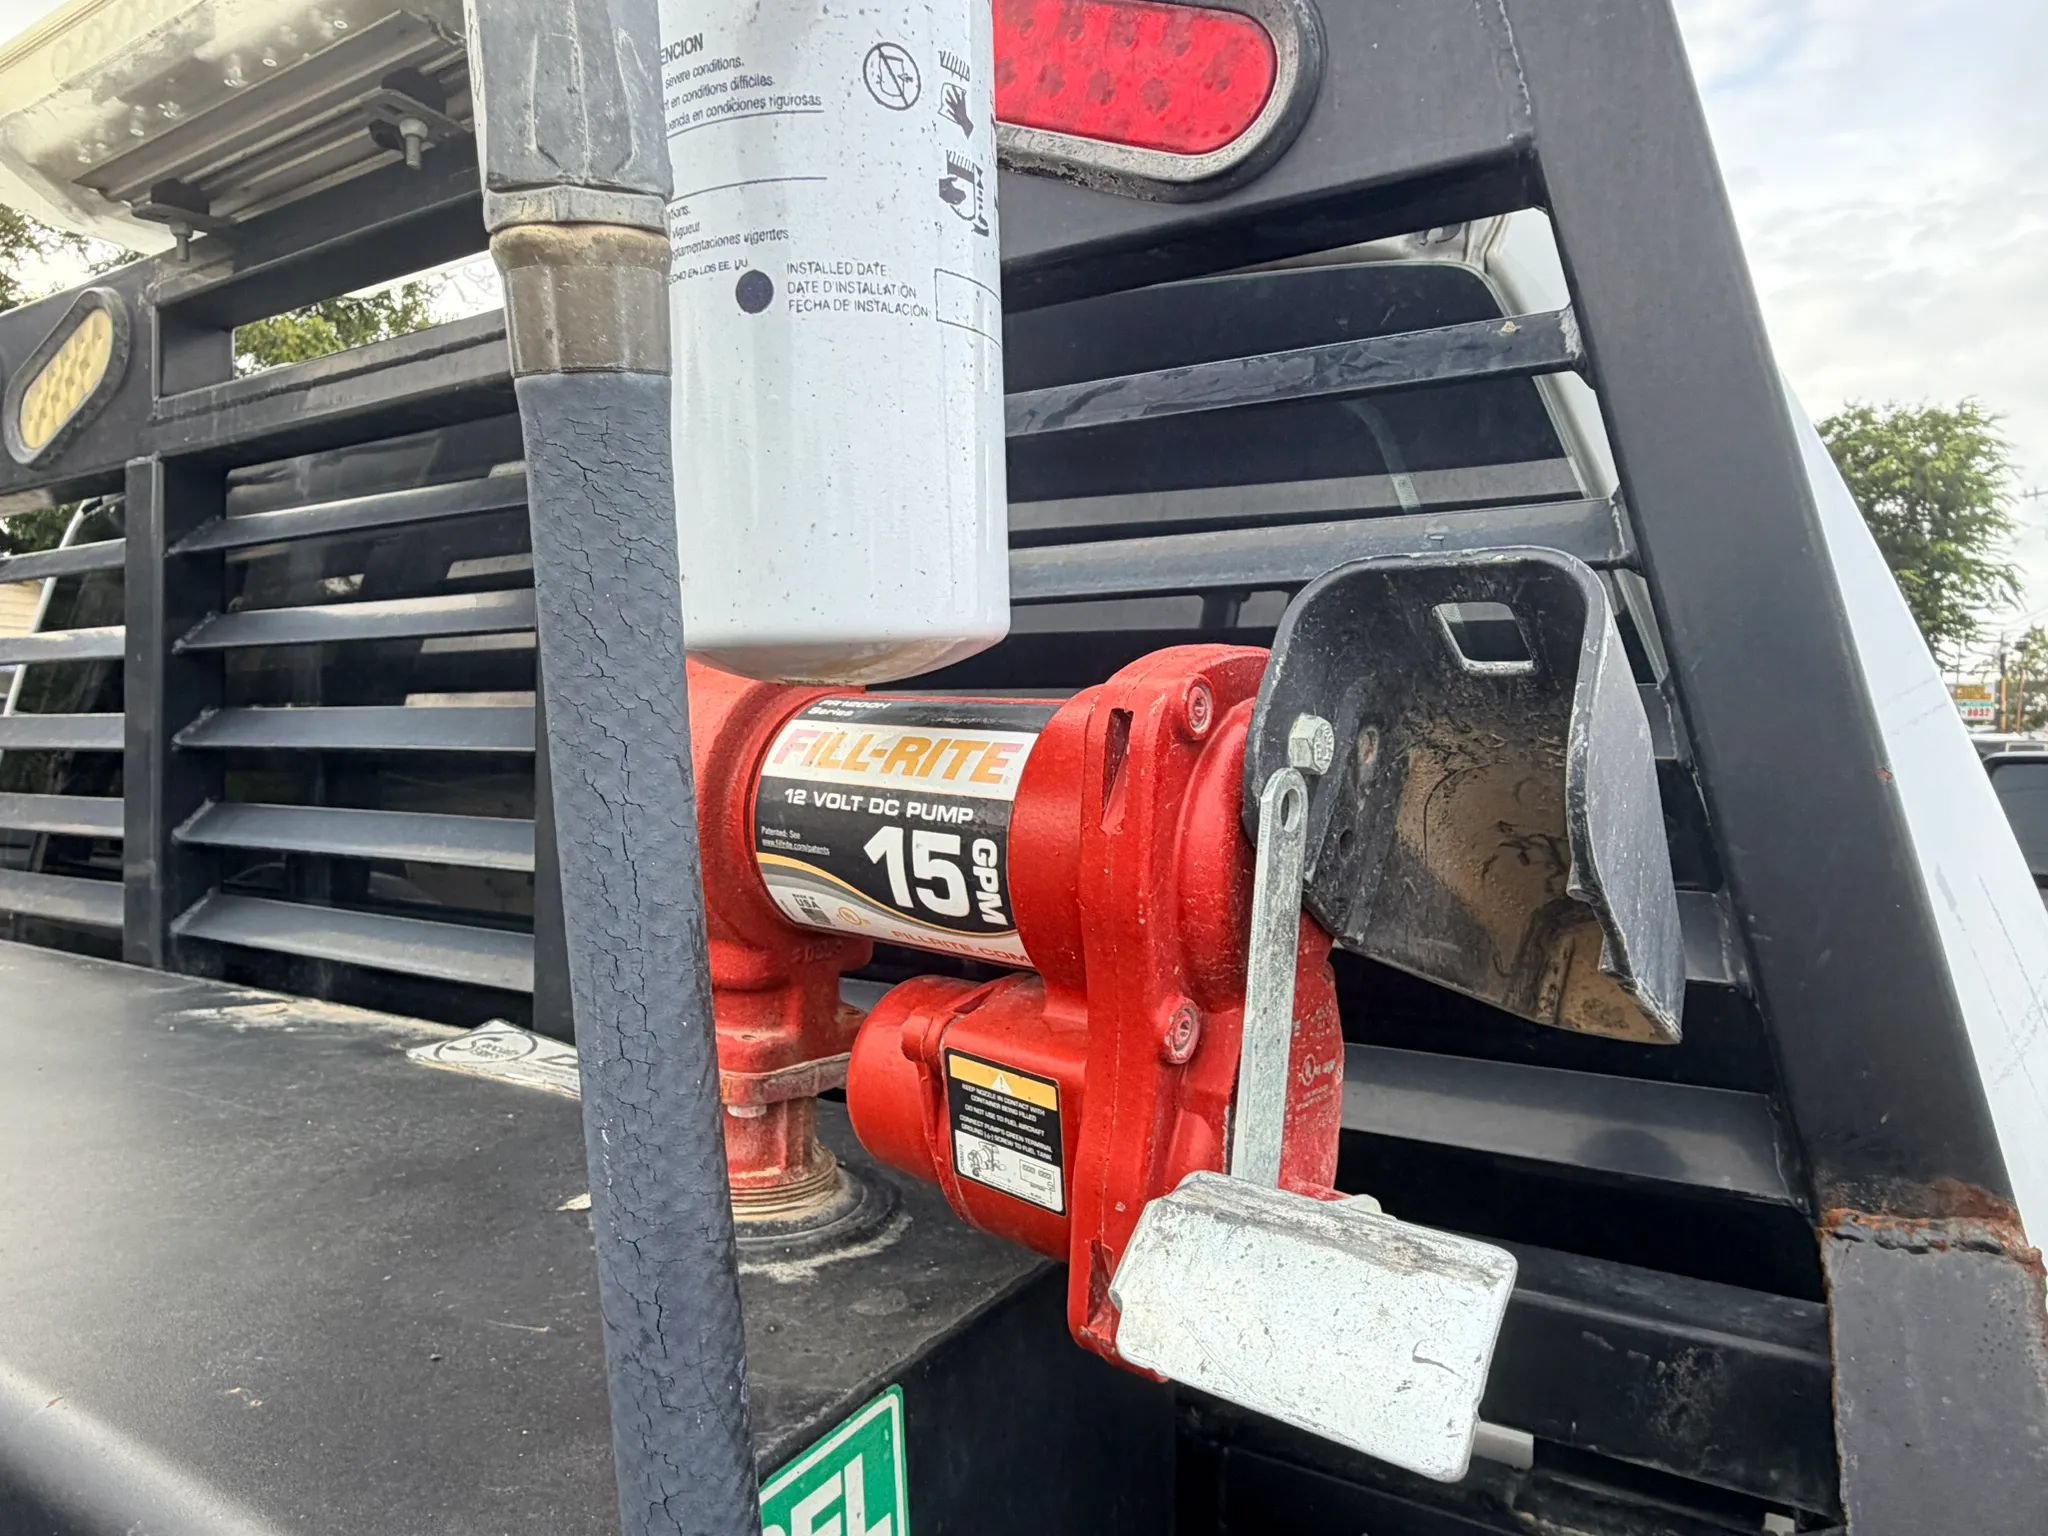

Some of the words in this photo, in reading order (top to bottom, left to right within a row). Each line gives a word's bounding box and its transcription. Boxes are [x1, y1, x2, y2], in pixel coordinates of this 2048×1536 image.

[660, 32, 704, 66] ENCION
[693, 56, 744, 78] conditions.
[682, 80, 728, 104] conditions
[692, 110, 704, 122] en
[706, 97, 766, 118] condiciones
[744, 228, 789, 246] vigentes
[700, 263, 716, 275] LOS
[786, 262, 854, 275] INSTALLED
[857, 262, 888, 276] DATE
[788, 280, 818, 294] DATE
[823, 280, 916, 298] D'INSTALLATION
[788, 299, 831, 313] FECHA
[833, 299, 850, 312] DE
[808, 706, 854, 716] Series
[772, 729, 1025, 784] FILL-RITE
[785, 788, 807, 806] 12
[813, 791, 862, 812] VOLT
[868, 798, 900, 816] DC
[906, 801, 974, 824] PUMP
[863, 825, 970, 918] 15
[972, 838, 1008, 926] GPM
[794, 898, 822, 909] USA
[891, 930, 1032, 963] FILLRITE.COM
